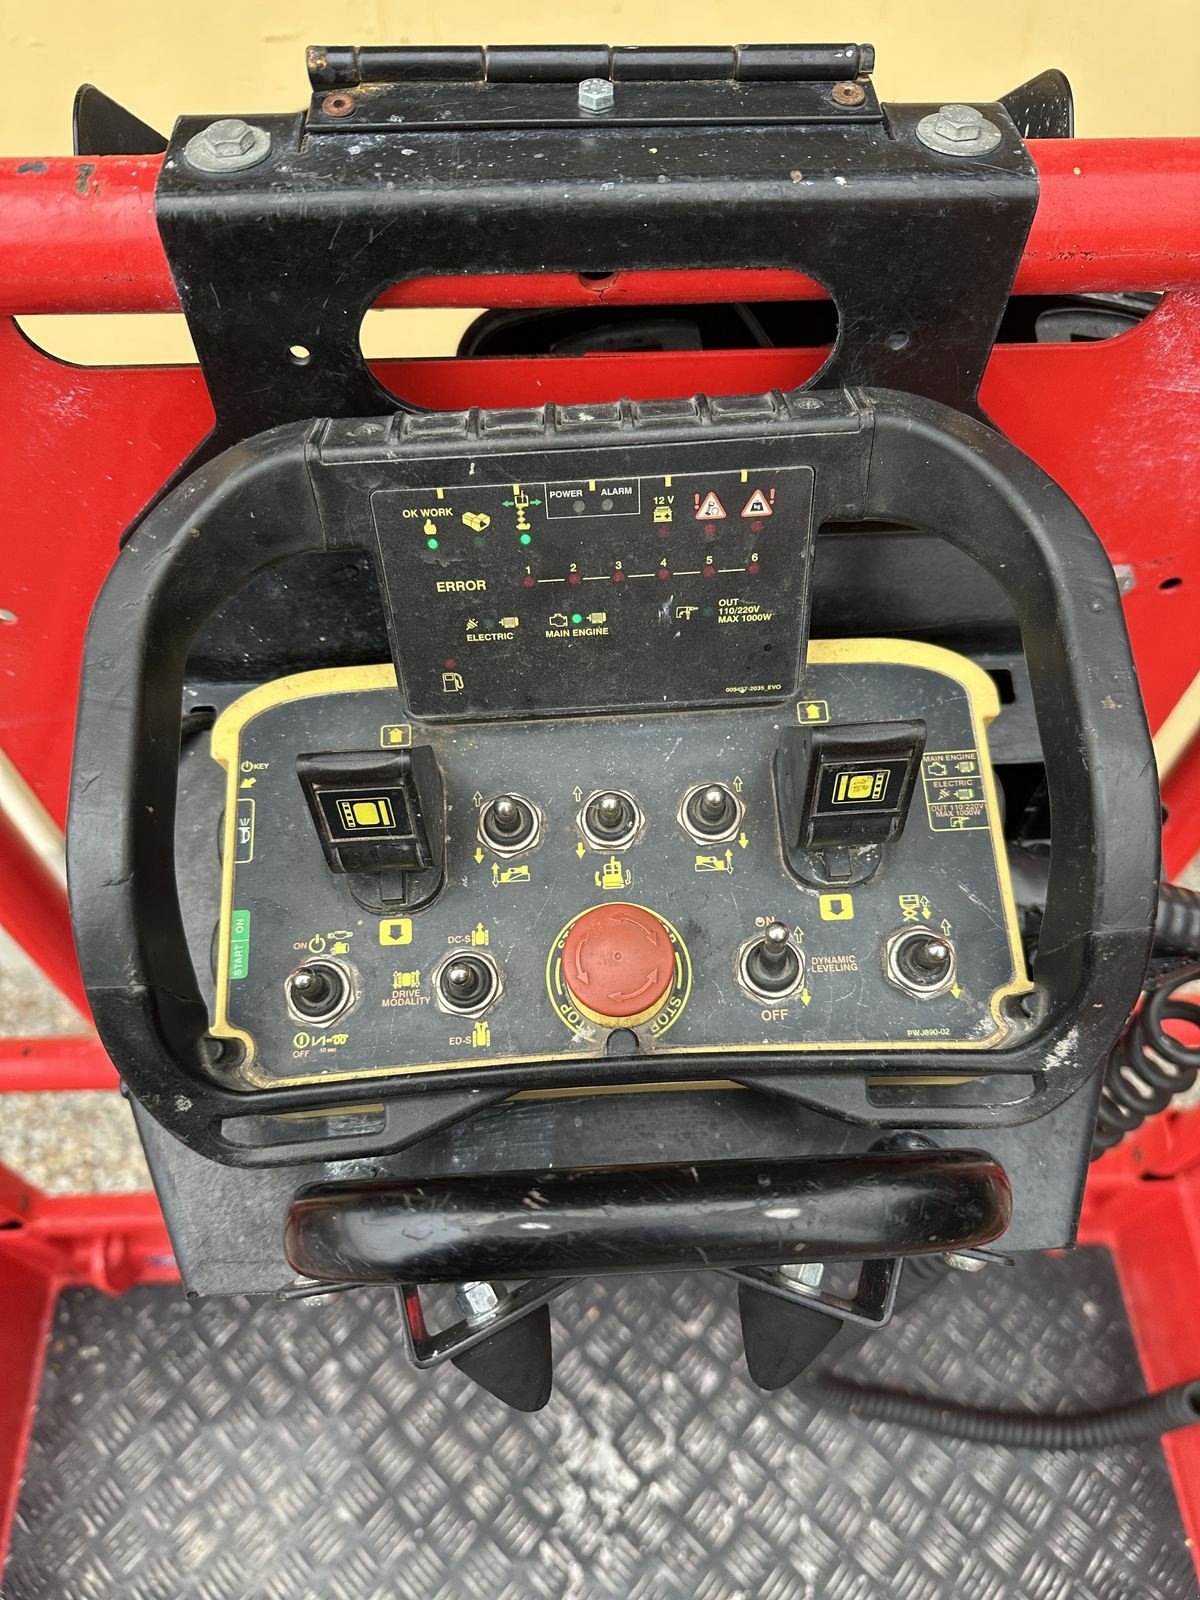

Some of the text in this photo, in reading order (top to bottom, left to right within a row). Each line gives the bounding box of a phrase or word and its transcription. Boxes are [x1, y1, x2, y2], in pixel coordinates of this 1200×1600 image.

[549, 490, 583, 498] POWER
[600, 487, 633, 496] ALARM
[653, 495, 675, 505] 12 V
[402, 507, 453, 518] OK WORK
[525, 553, 758, 574] 1 2 3 4 5 6
[436, 580, 486, 592] ERROR
[718, 598, 739, 607] OUT
[718, 605, 760, 615] 110/220V
[718, 613, 772, 624] MAX 1000W
[466, 632, 514, 642] ELECTRIC
[545, 627, 609, 638] MAIN ENGINE
[945, 753, 976, 761] ENGINE
[933, 780, 973, 788] ELECTRIC
[235, 918, 245, 934] ON
[755, 916, 775, 927] ON
[447, 935, 471, 944] DC-S
[293, 942, 308, 950] ON
[234, 944, 244, 976] START
[811, 955, 856, 965] DYNAMIC
[811, 963, 858, 973] LEVELING
[392, 989, 421, 998] DRIVE
[382, 996, 431, 1007] MODALITY
[651, 996, 682, 1033] STOP
[761, 1009, 789, 1021] OFF
[907, 1028, 951, 1037] PWJ890-02
[449, 1036, 472, 1045] ED-S
[292, 1050, 310, 1058] OFF
